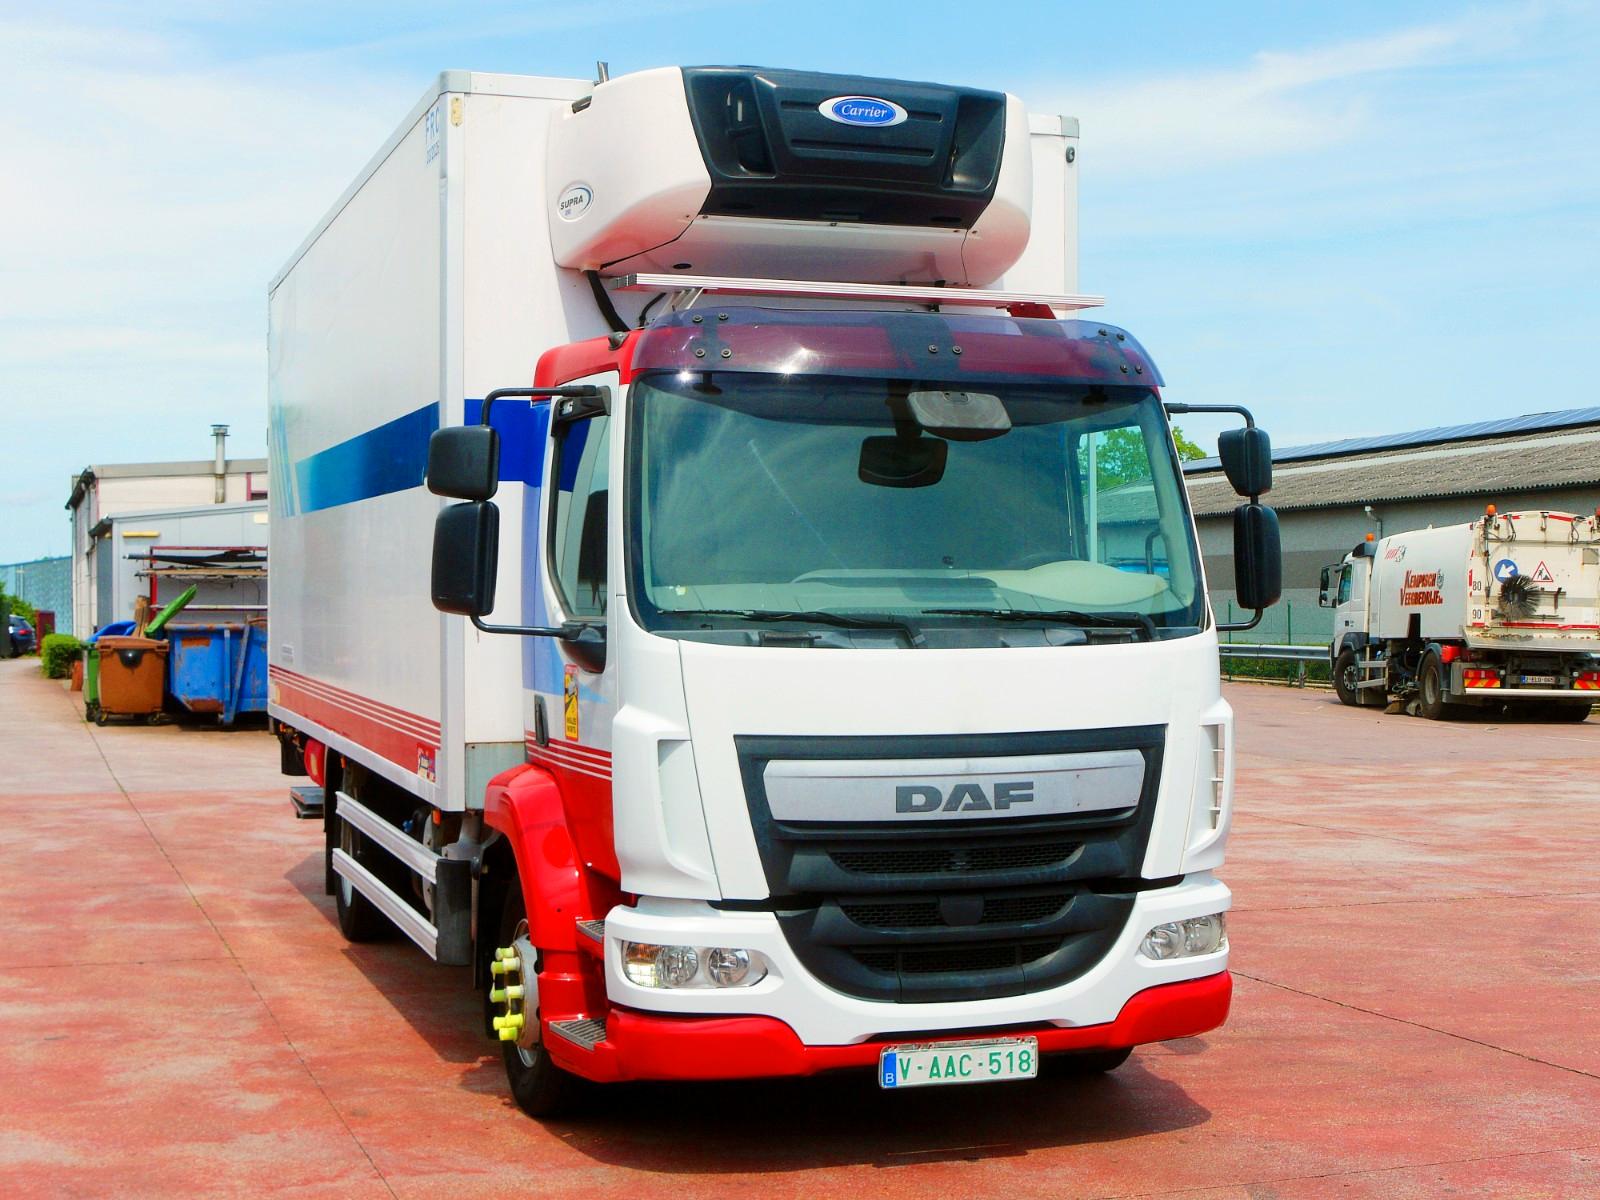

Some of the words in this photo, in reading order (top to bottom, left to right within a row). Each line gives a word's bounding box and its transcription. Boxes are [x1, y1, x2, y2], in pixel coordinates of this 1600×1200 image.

[841, 104, 888, 118] Carrier
[560, 195, 584, 210] SUPRA
[1472, 580, 1482, 591] 80
[1472, 609, 1482, 619] 90
[895, 781, 1034, 813] DAF
[885, 1072, 895, 1084] B
